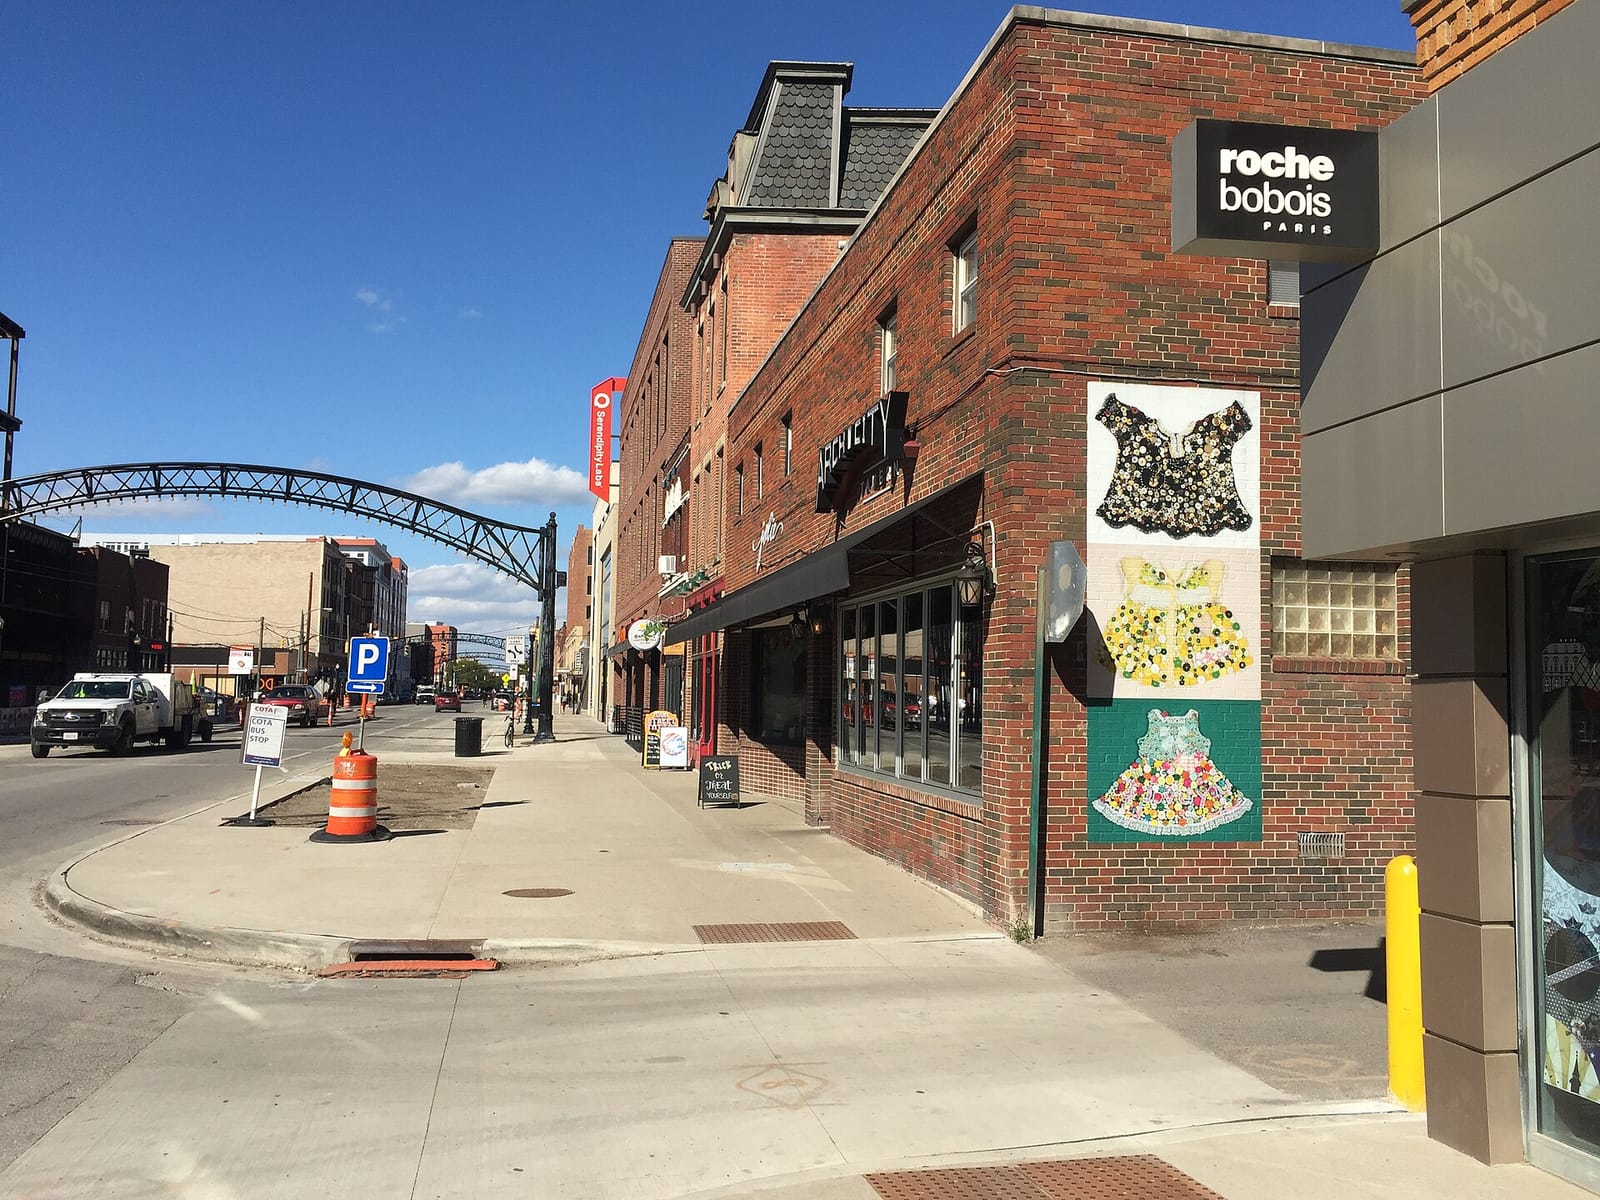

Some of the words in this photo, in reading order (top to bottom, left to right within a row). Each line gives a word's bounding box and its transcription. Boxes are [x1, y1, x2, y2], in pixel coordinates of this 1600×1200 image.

[1220, 146, 1335, 181] roche
[1220, 178, 1332, 217] bobois
[1263, 221, 1332, 235] PARIS
[854, 393, 892, 457] CITY
[357, 643, 380, 675] P
[252, 718, 272, 726] COTA
[250, 726, 265, 734] BUS
[250, 735, 269, 743] STOP
[705, 760, 732, 772] TRICK
